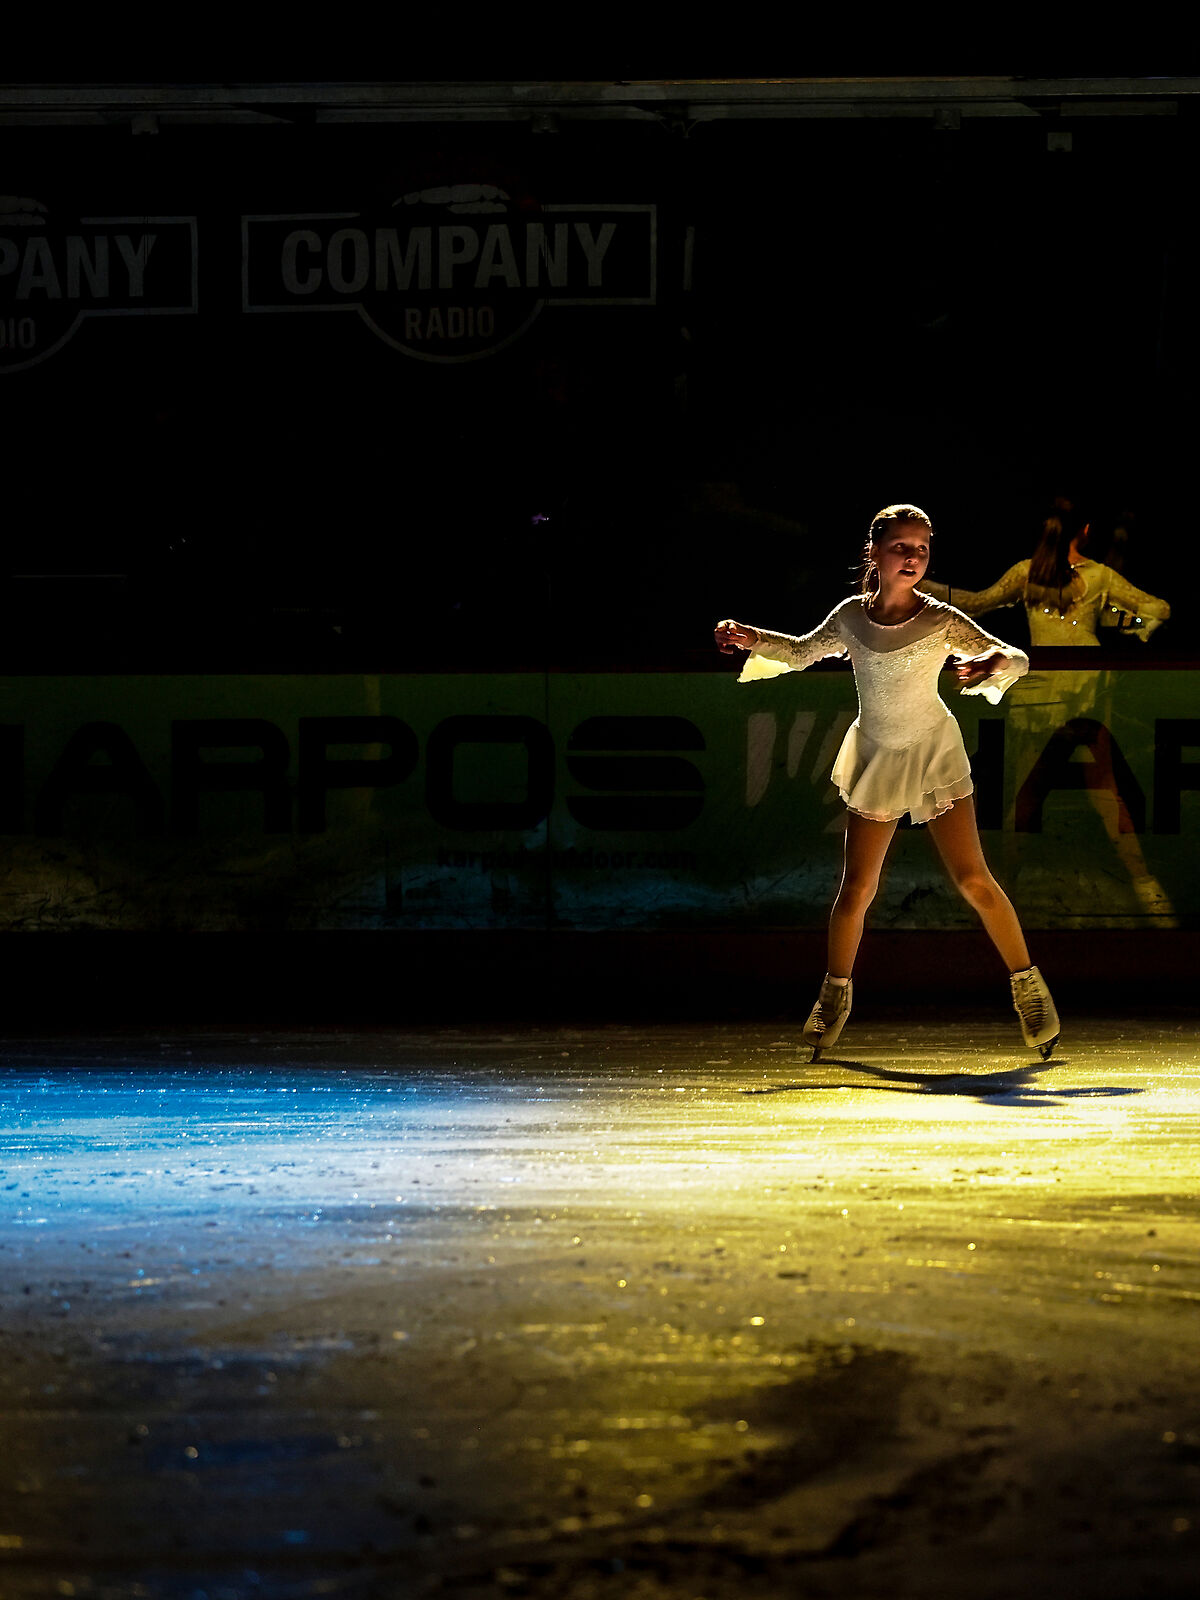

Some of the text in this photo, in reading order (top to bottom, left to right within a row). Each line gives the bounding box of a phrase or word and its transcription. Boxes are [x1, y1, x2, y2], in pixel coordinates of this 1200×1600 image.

[280, 222, 618, 296] COMPANY
[404, 304, 497, 341] RADIO
[0, 714, 706, 838] ARPOS
